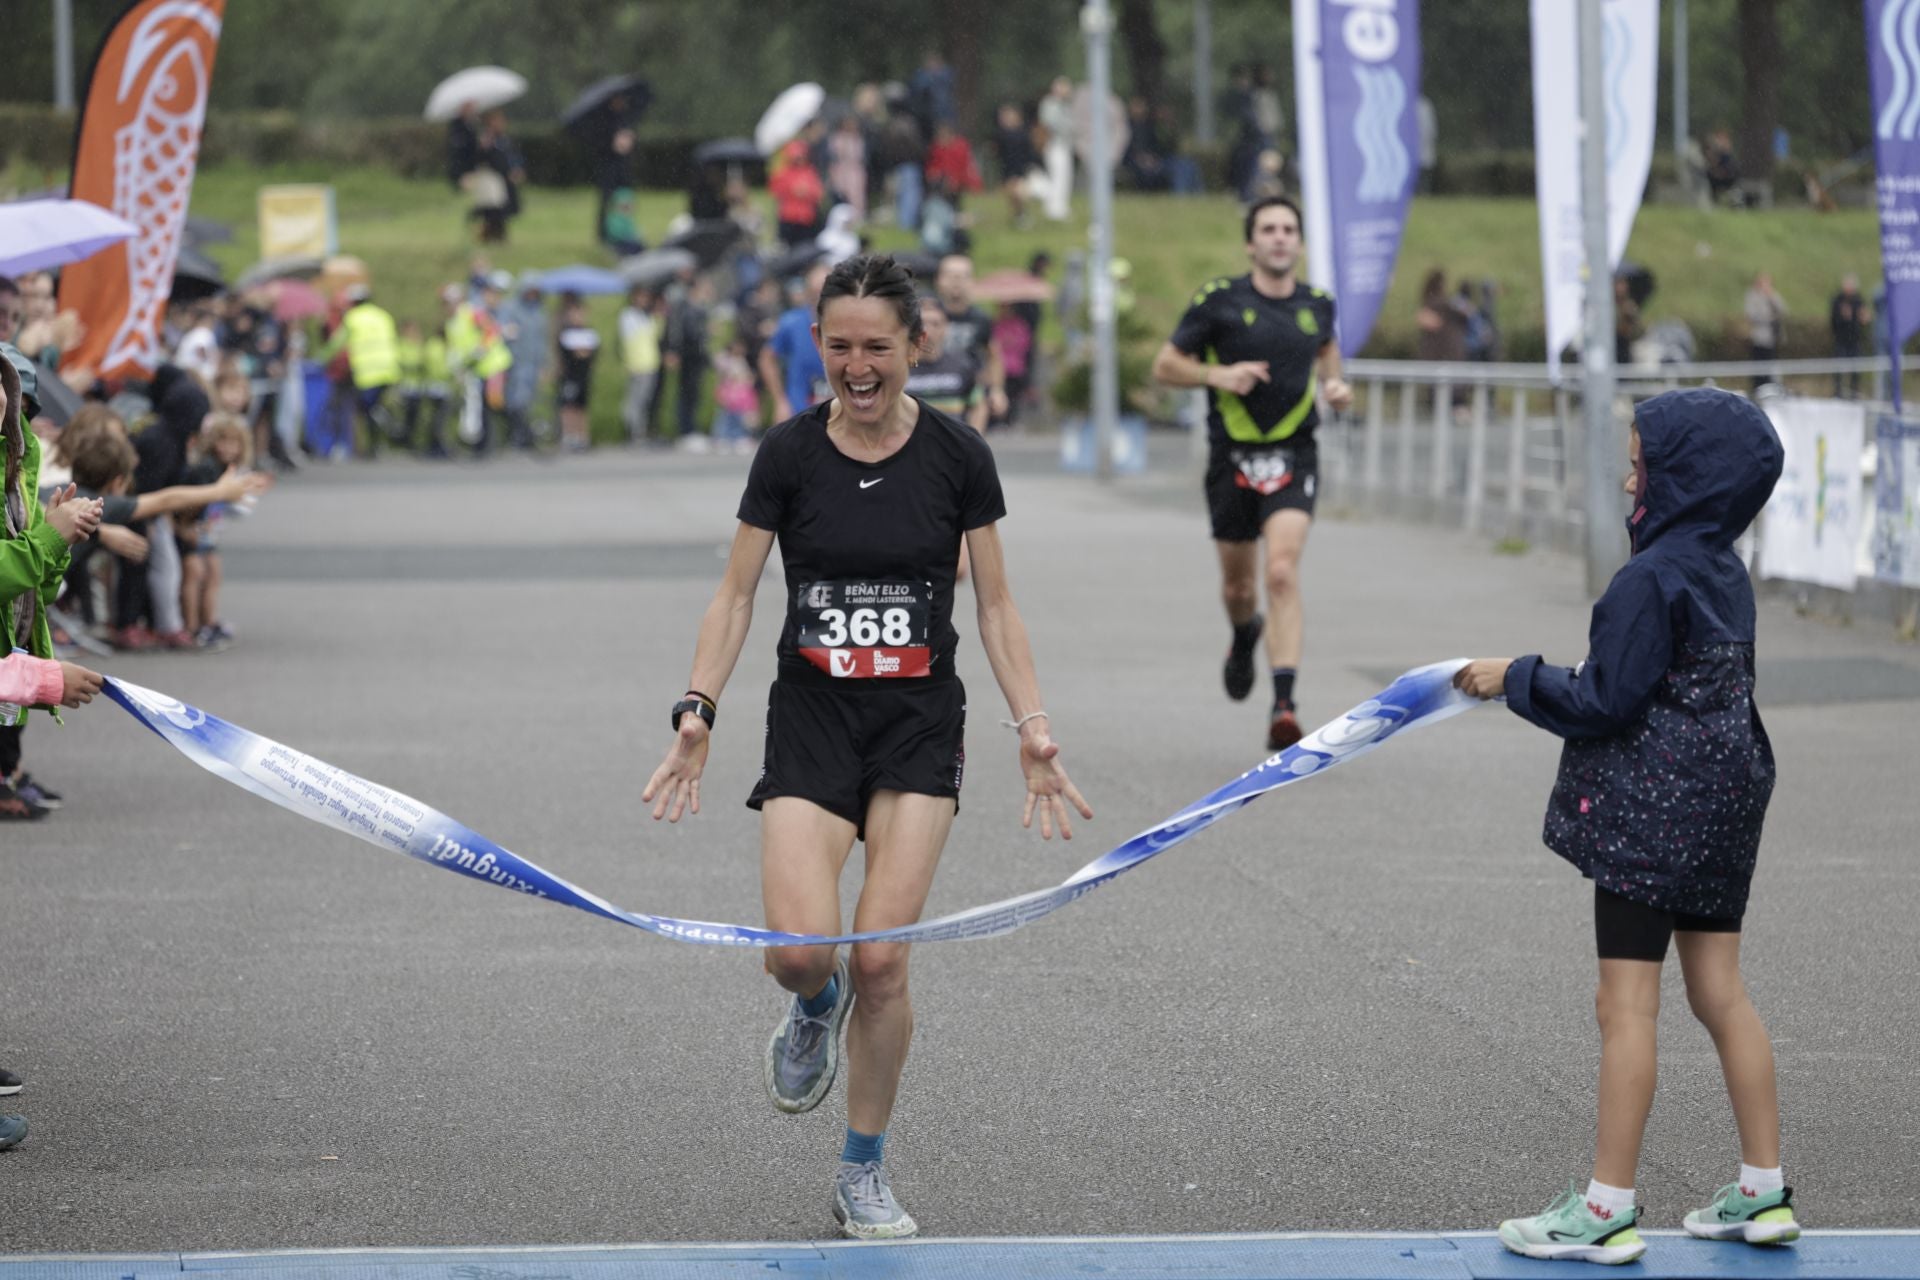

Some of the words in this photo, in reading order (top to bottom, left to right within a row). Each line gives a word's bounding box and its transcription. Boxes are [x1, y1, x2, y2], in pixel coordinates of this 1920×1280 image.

[845, 583, 880, 595] BEÑAT
[882, 585, 909, 595] ELZO
[819, 608, 911, 646] 368
[874, 657, 900, 666] DIARIO
[874, 665, 899, 673] VASCO
[304, 764, 330, 787] Bidasoa
[299, 781, 326, 806] Gaindiko
[328, 796, 348, 817] Mugaz
[348, 812, 376, 834] Txingudi
[382, 811, 415, 837] Consorcio
